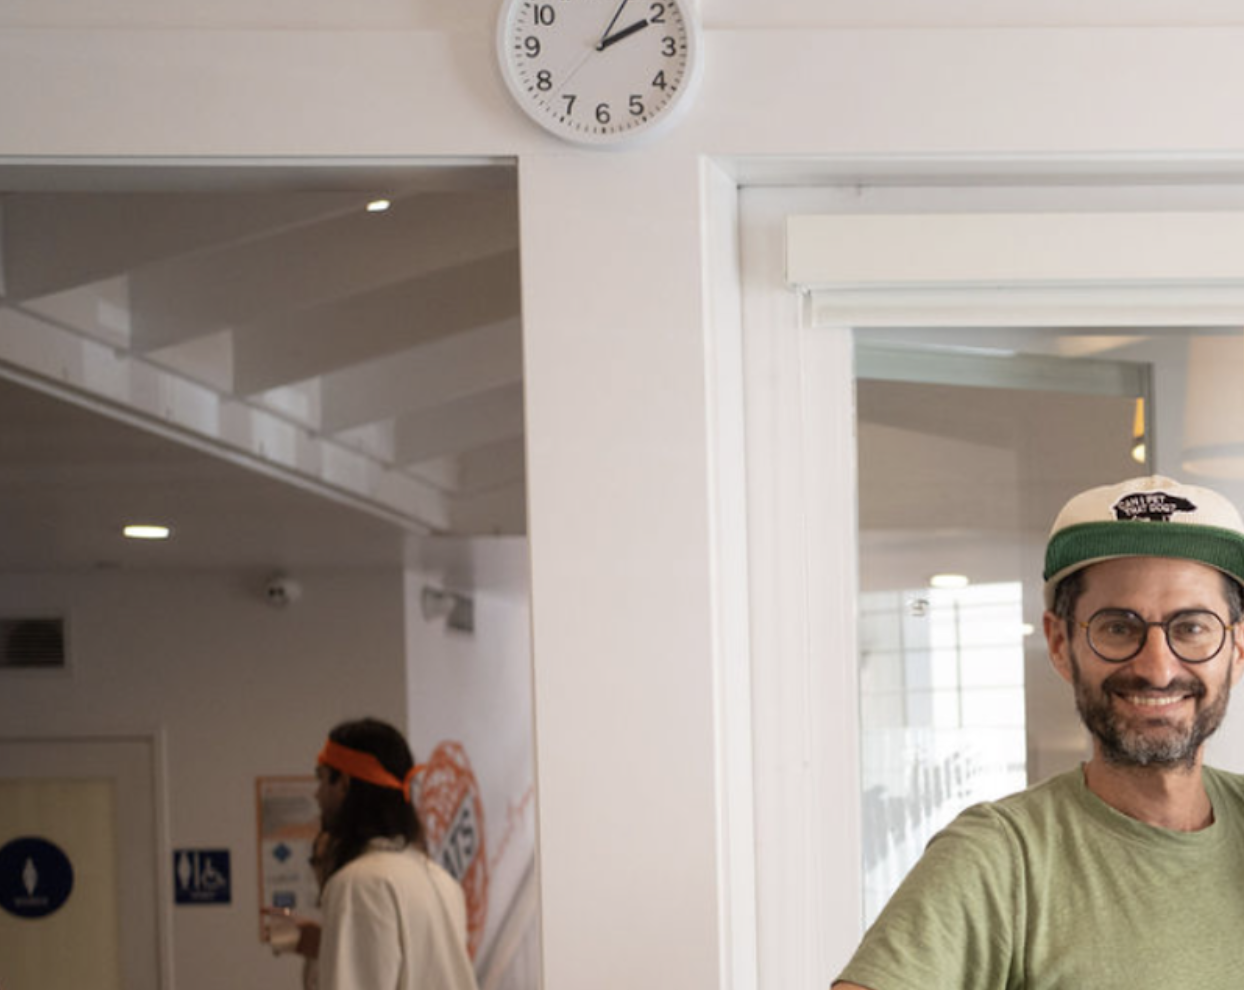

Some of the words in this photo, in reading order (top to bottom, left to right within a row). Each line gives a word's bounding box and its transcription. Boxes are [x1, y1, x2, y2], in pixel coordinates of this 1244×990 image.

[533, 4, 555, 26] 10
[650, 3, 666, 24] 2
[524, 36, 541, 58] 9
[661, 36, 677, 57] 3
[536, 70, 552, 91] 8
[652, 70, 667, 91] 4
[562, 95, 577, 115] 7
[595, 103, 611, 124] 6
[628, 95, 645, 116] 5
[1117, 496, 1138, 511] CAN
